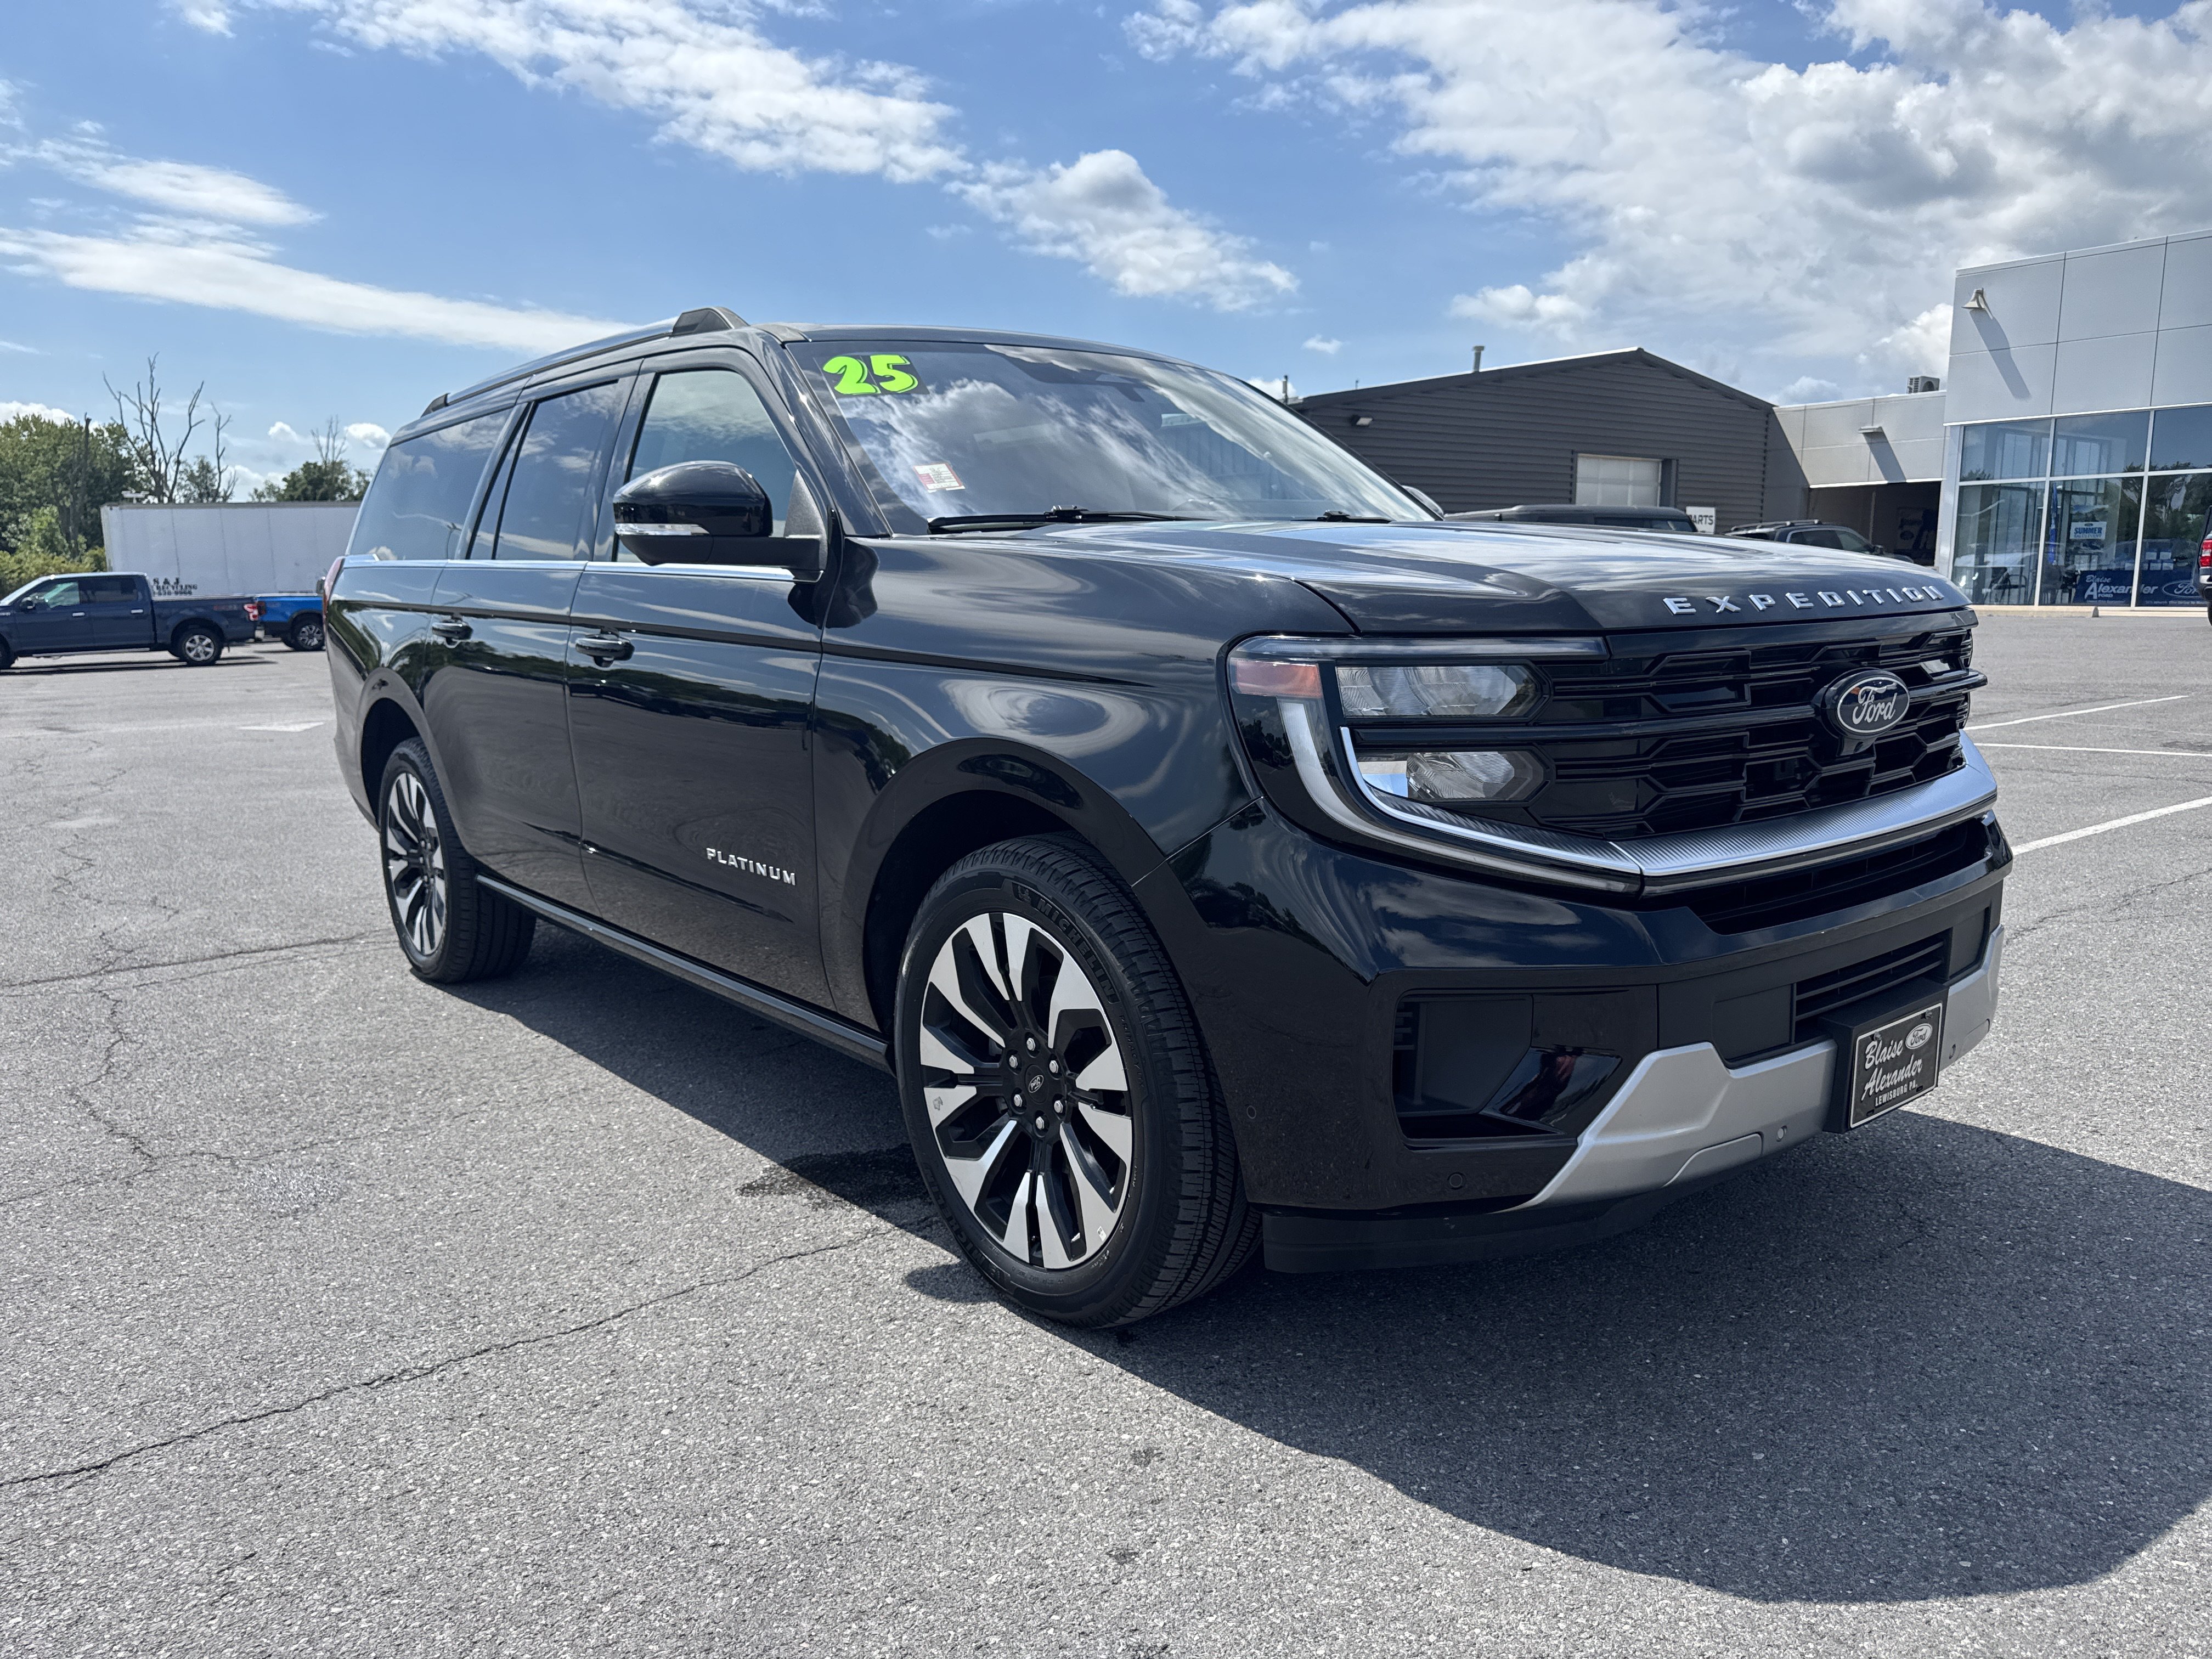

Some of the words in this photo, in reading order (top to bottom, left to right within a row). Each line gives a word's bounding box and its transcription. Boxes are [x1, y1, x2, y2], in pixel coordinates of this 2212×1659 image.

[823, 354, 918, 395] 25
[2085, 574, 2111, 583] Blaise
[2174, 583, 2198, 594] For
[1663, 585, 1945, 616] EXPEDITION
[1852, 682, 1898, 725] Ford
[706, 848, 796, 886] PLATINUM
[1036, 898, 1118, 996] MICHELIN
[1911, 1028, 1928, 1046] Ford
[1865, 1040, 1903, 1069] Blaise
[1861, 1054, 1922, 1101] Alexander
[1875, 1084, 1908, 1106] LEWISBURG
[1909, 1080, 1918, 1091] PA.
